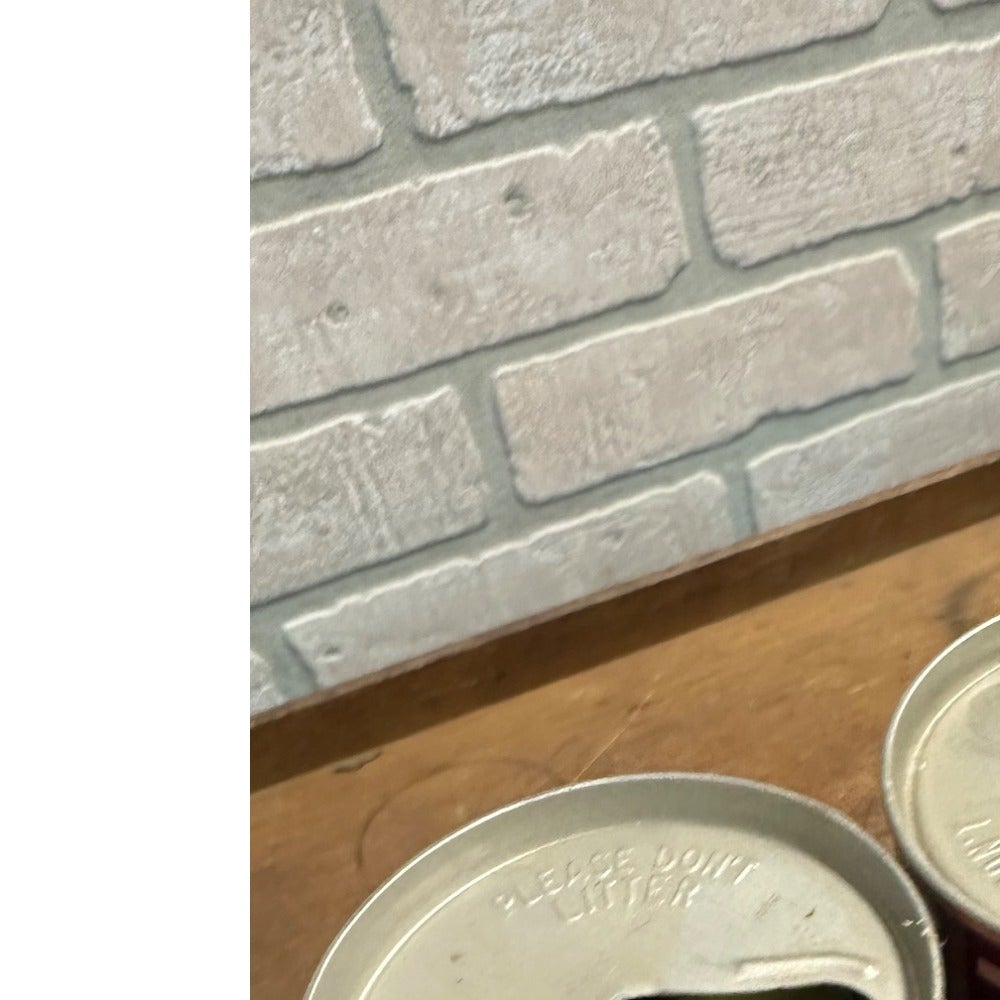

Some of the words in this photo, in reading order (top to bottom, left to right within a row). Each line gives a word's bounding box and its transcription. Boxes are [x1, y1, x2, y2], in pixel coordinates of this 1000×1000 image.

[494, 846, 638, 919] PLEASE
[652, 843, 761, 887] DON'T
[554, 873, 703, 923] LITTER
